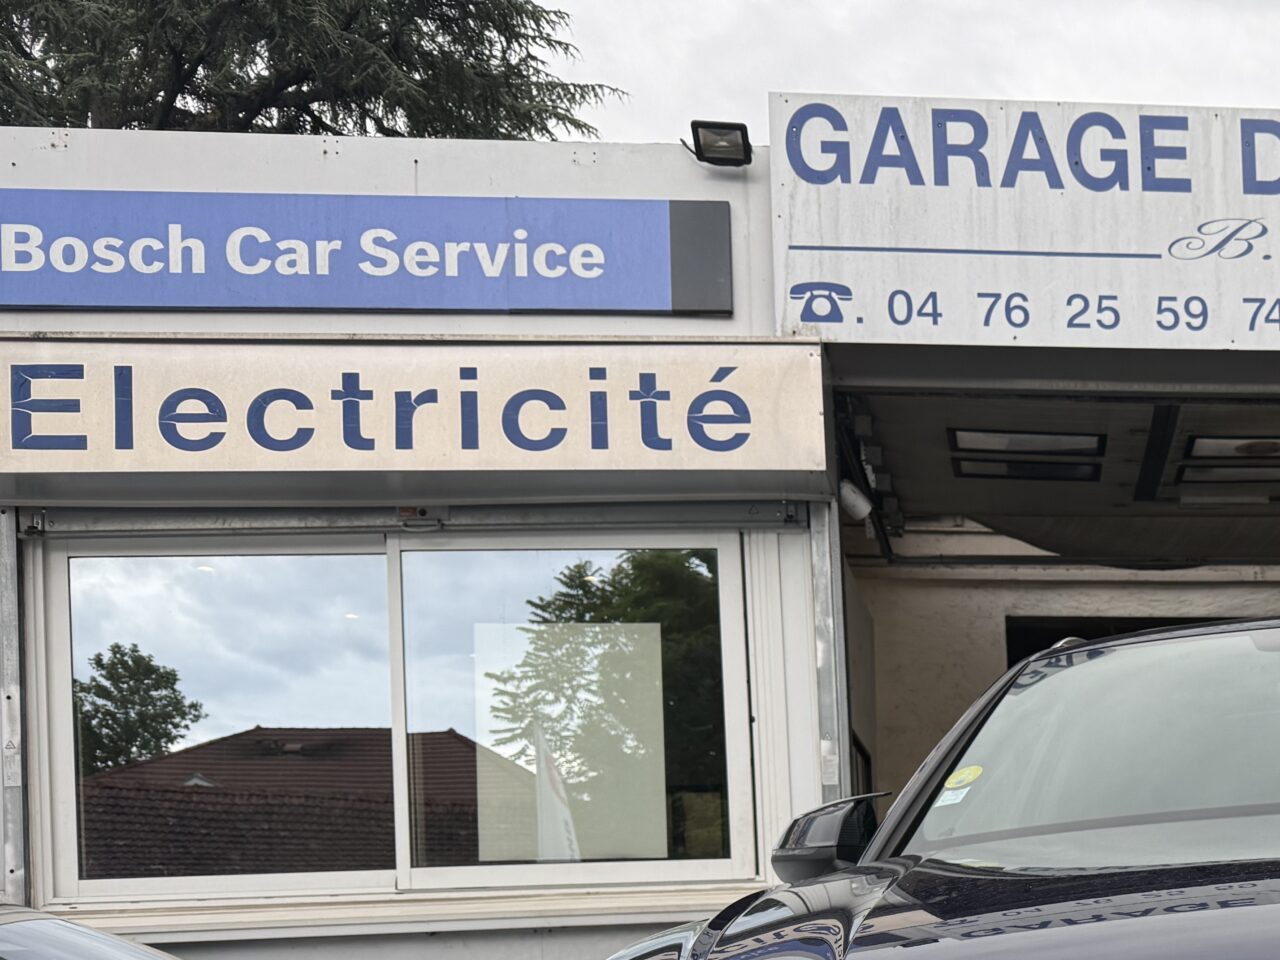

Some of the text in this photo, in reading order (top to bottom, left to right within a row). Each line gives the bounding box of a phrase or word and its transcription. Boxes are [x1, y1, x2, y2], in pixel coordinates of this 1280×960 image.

[786, 103, 1193, 193] GARAGE
[1, 223, 606, 279] Bosch Car Service
[1168, 217, 1272, 261] B.
[887, 289, 943, 326] 04
[976, 291, 1031, 329] 76
[1065, 293, 1121, 330] 25
[1155, 295, 1209, 332] 59
[10, 364, 752, 453] Electricité
